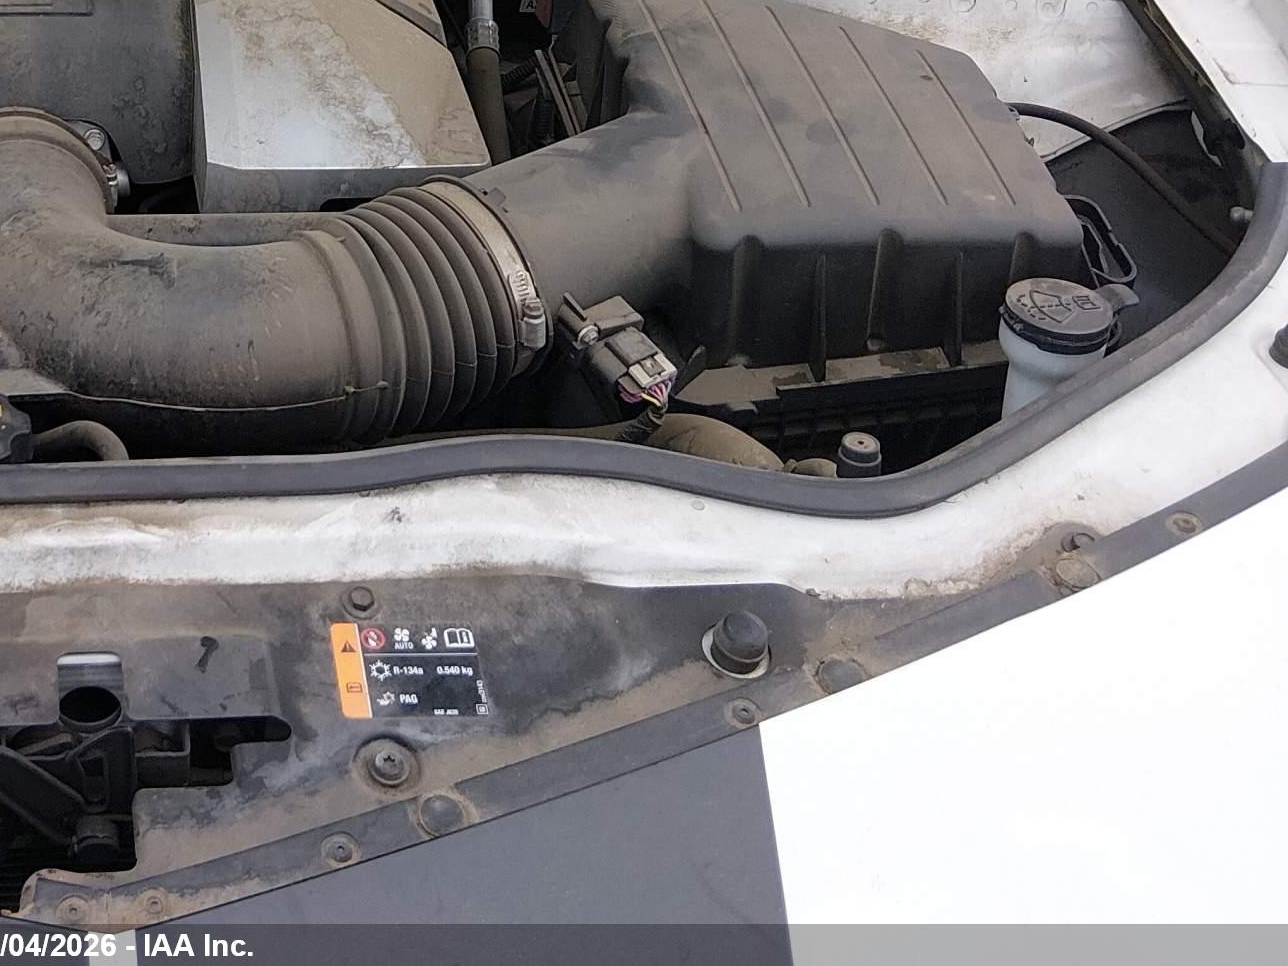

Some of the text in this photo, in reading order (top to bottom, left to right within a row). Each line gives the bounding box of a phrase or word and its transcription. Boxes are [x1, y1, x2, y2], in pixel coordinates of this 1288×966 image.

[394, 642, 414, 650] AUTO
[393, 665, 424, 675] R-134a
[460, 665, 474, 677] kg
[399, 693, 419, 704] PAG
